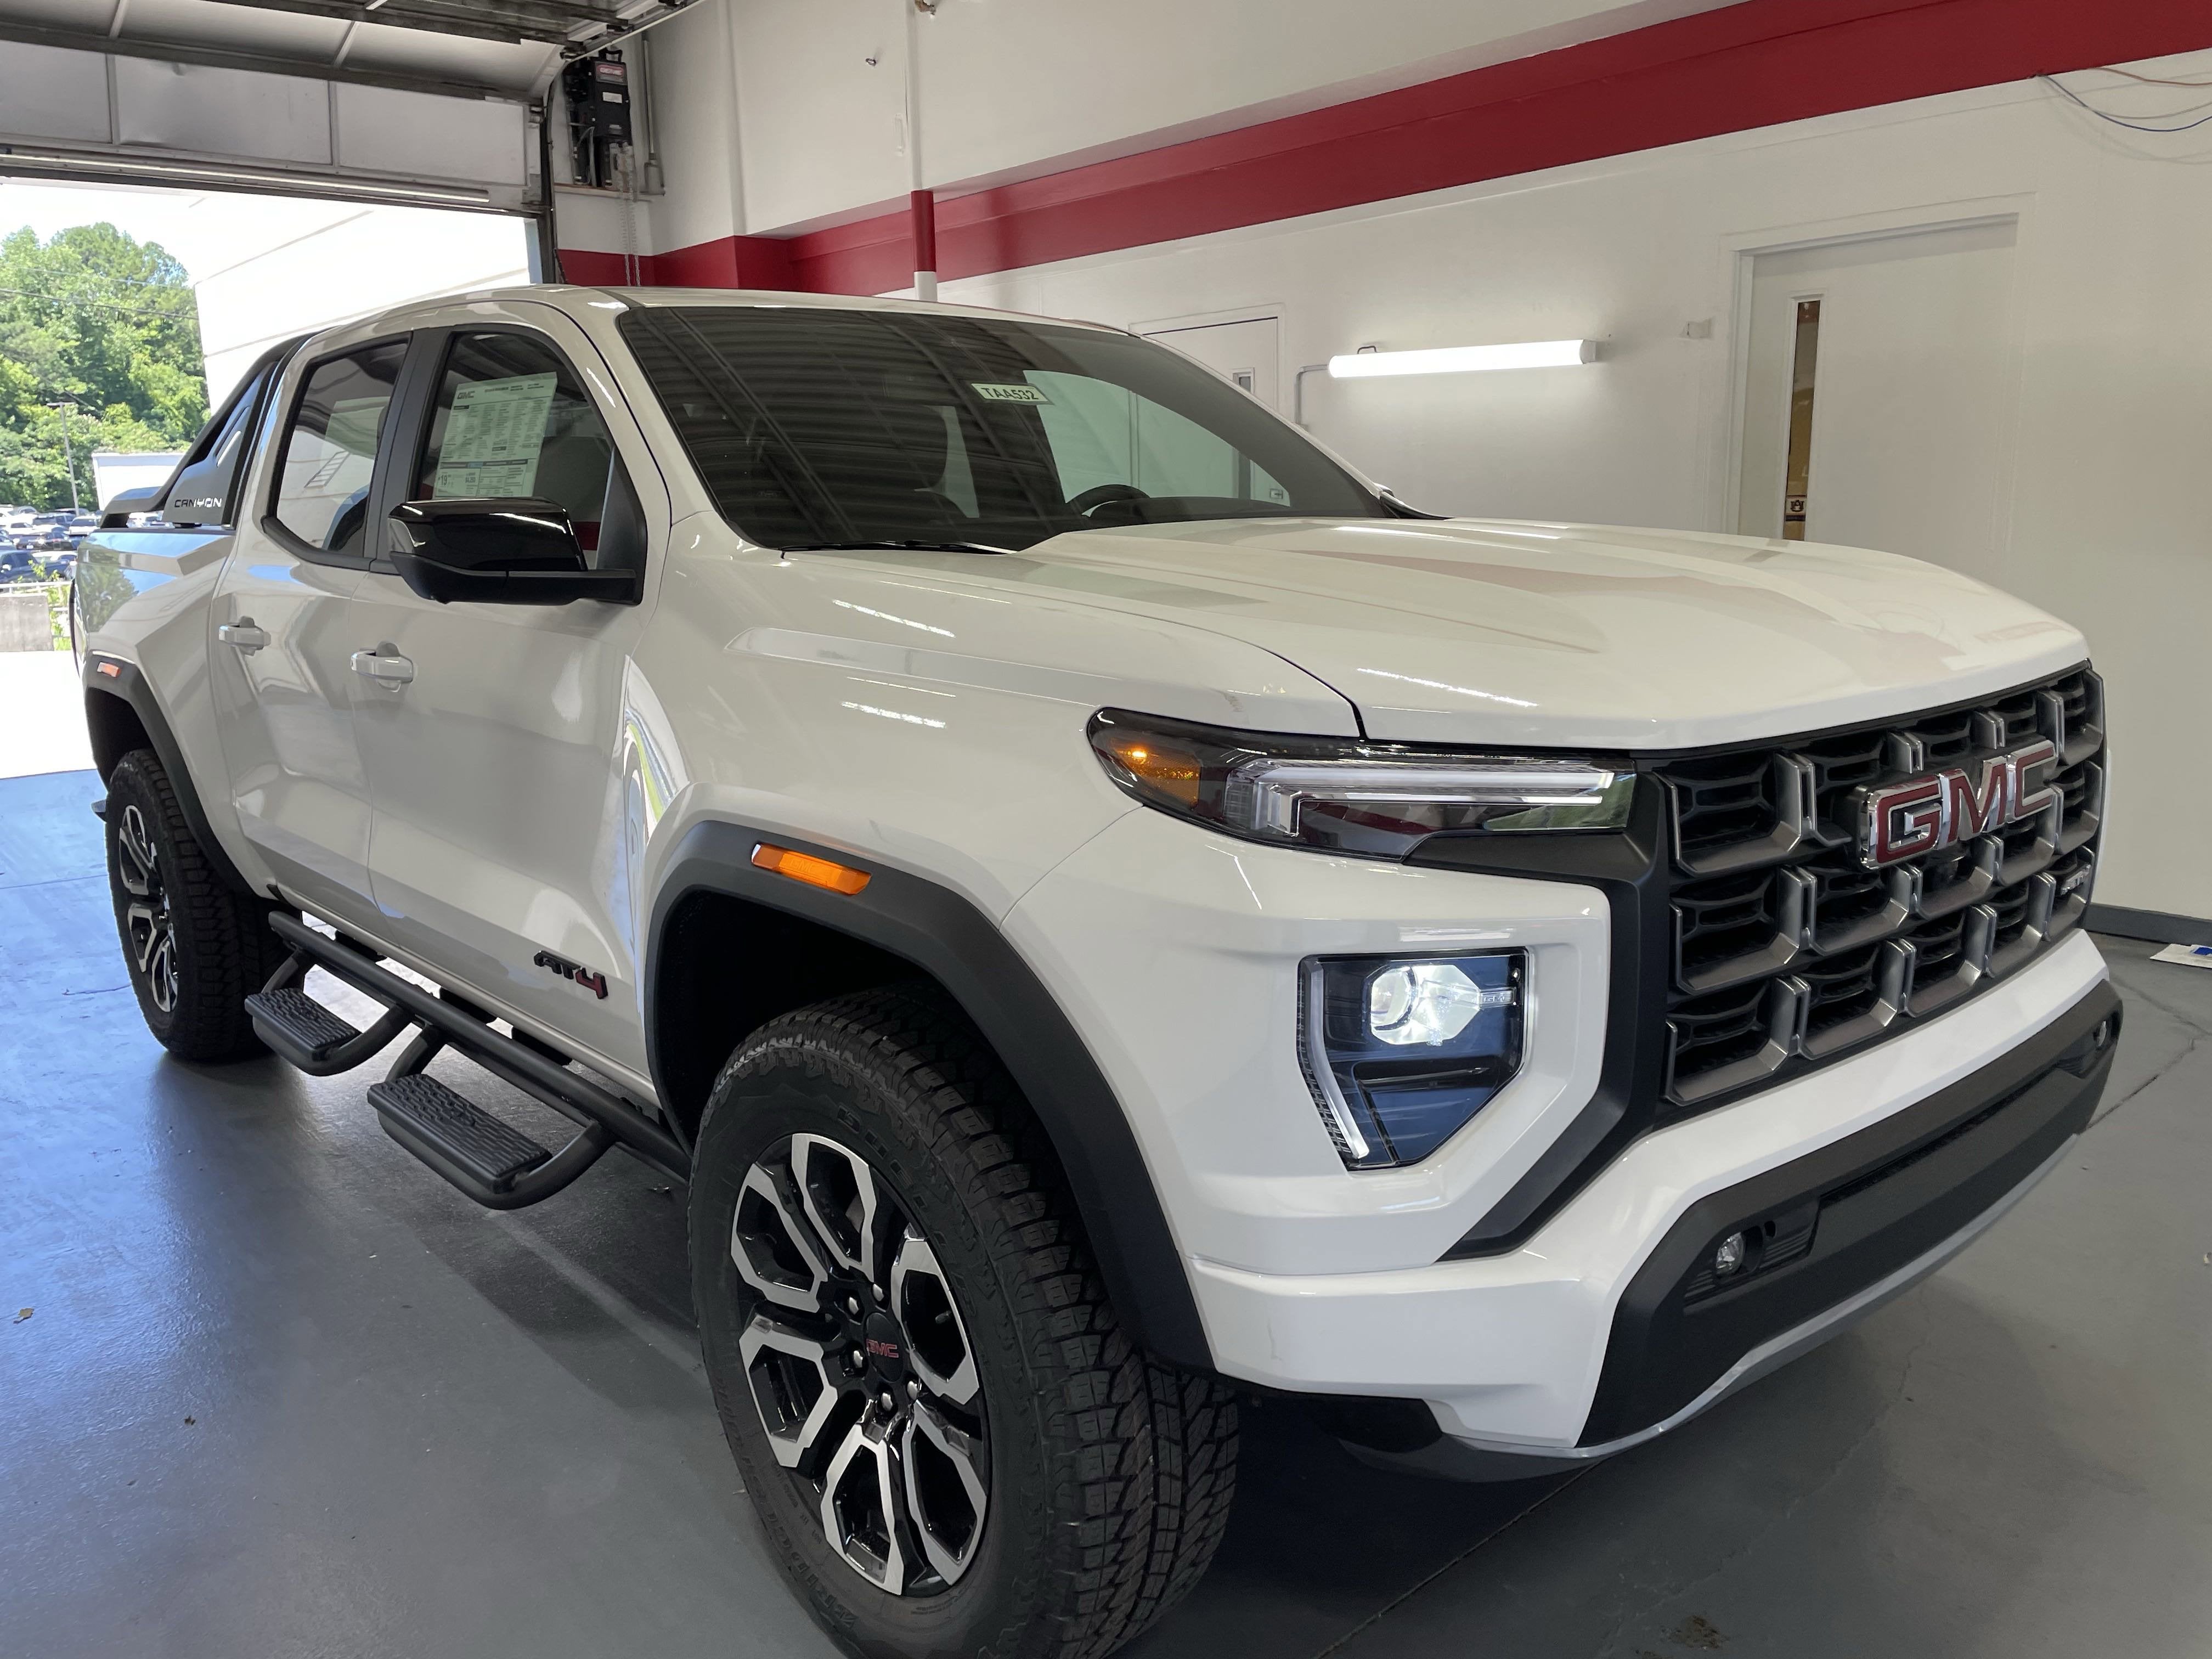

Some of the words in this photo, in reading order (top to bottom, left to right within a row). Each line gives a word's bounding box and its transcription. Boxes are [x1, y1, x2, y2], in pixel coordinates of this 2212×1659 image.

[980, 387, 1039, 400] TAA532
[174, 497, 222, 507] CANYON
[1860, 739, 2057, 870] GMC
[533, 950, 608, 1000] AT4
[1483, 995, 1510, 1003] GM
[866, 1339, 899, 1358] GMC
